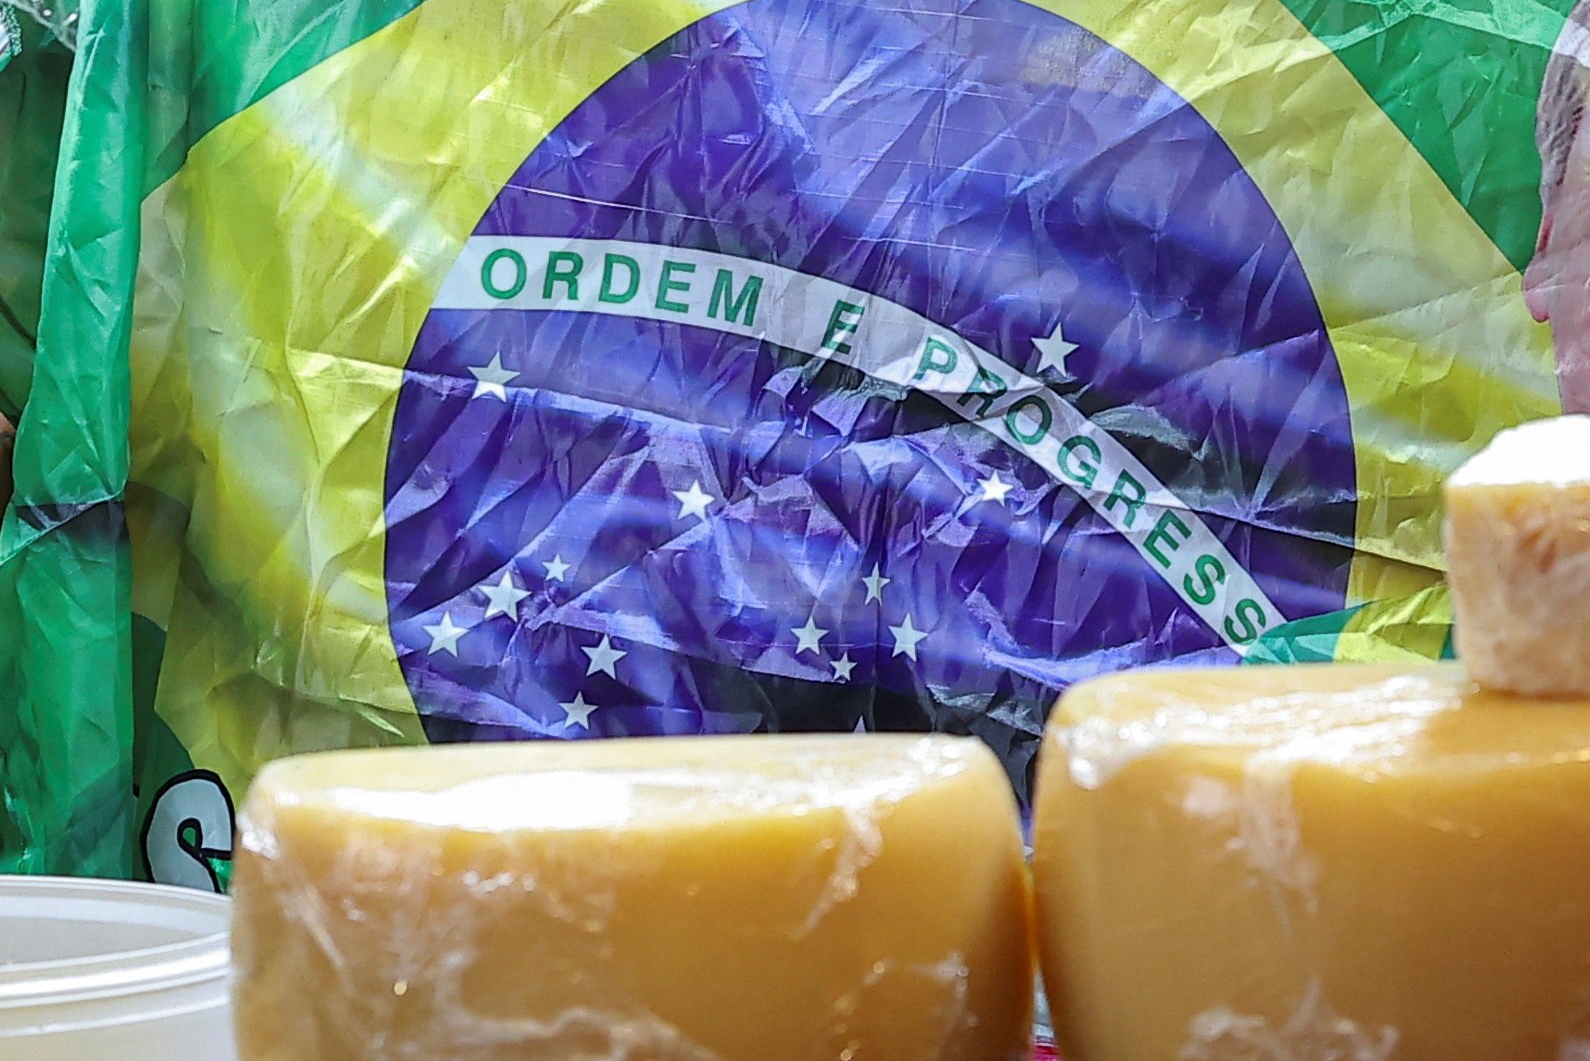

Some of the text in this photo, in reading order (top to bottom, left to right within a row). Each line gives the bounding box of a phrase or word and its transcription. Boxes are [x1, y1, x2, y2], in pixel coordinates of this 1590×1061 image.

[480, 247, 1267, 646] ORDEM E PROGRESS
